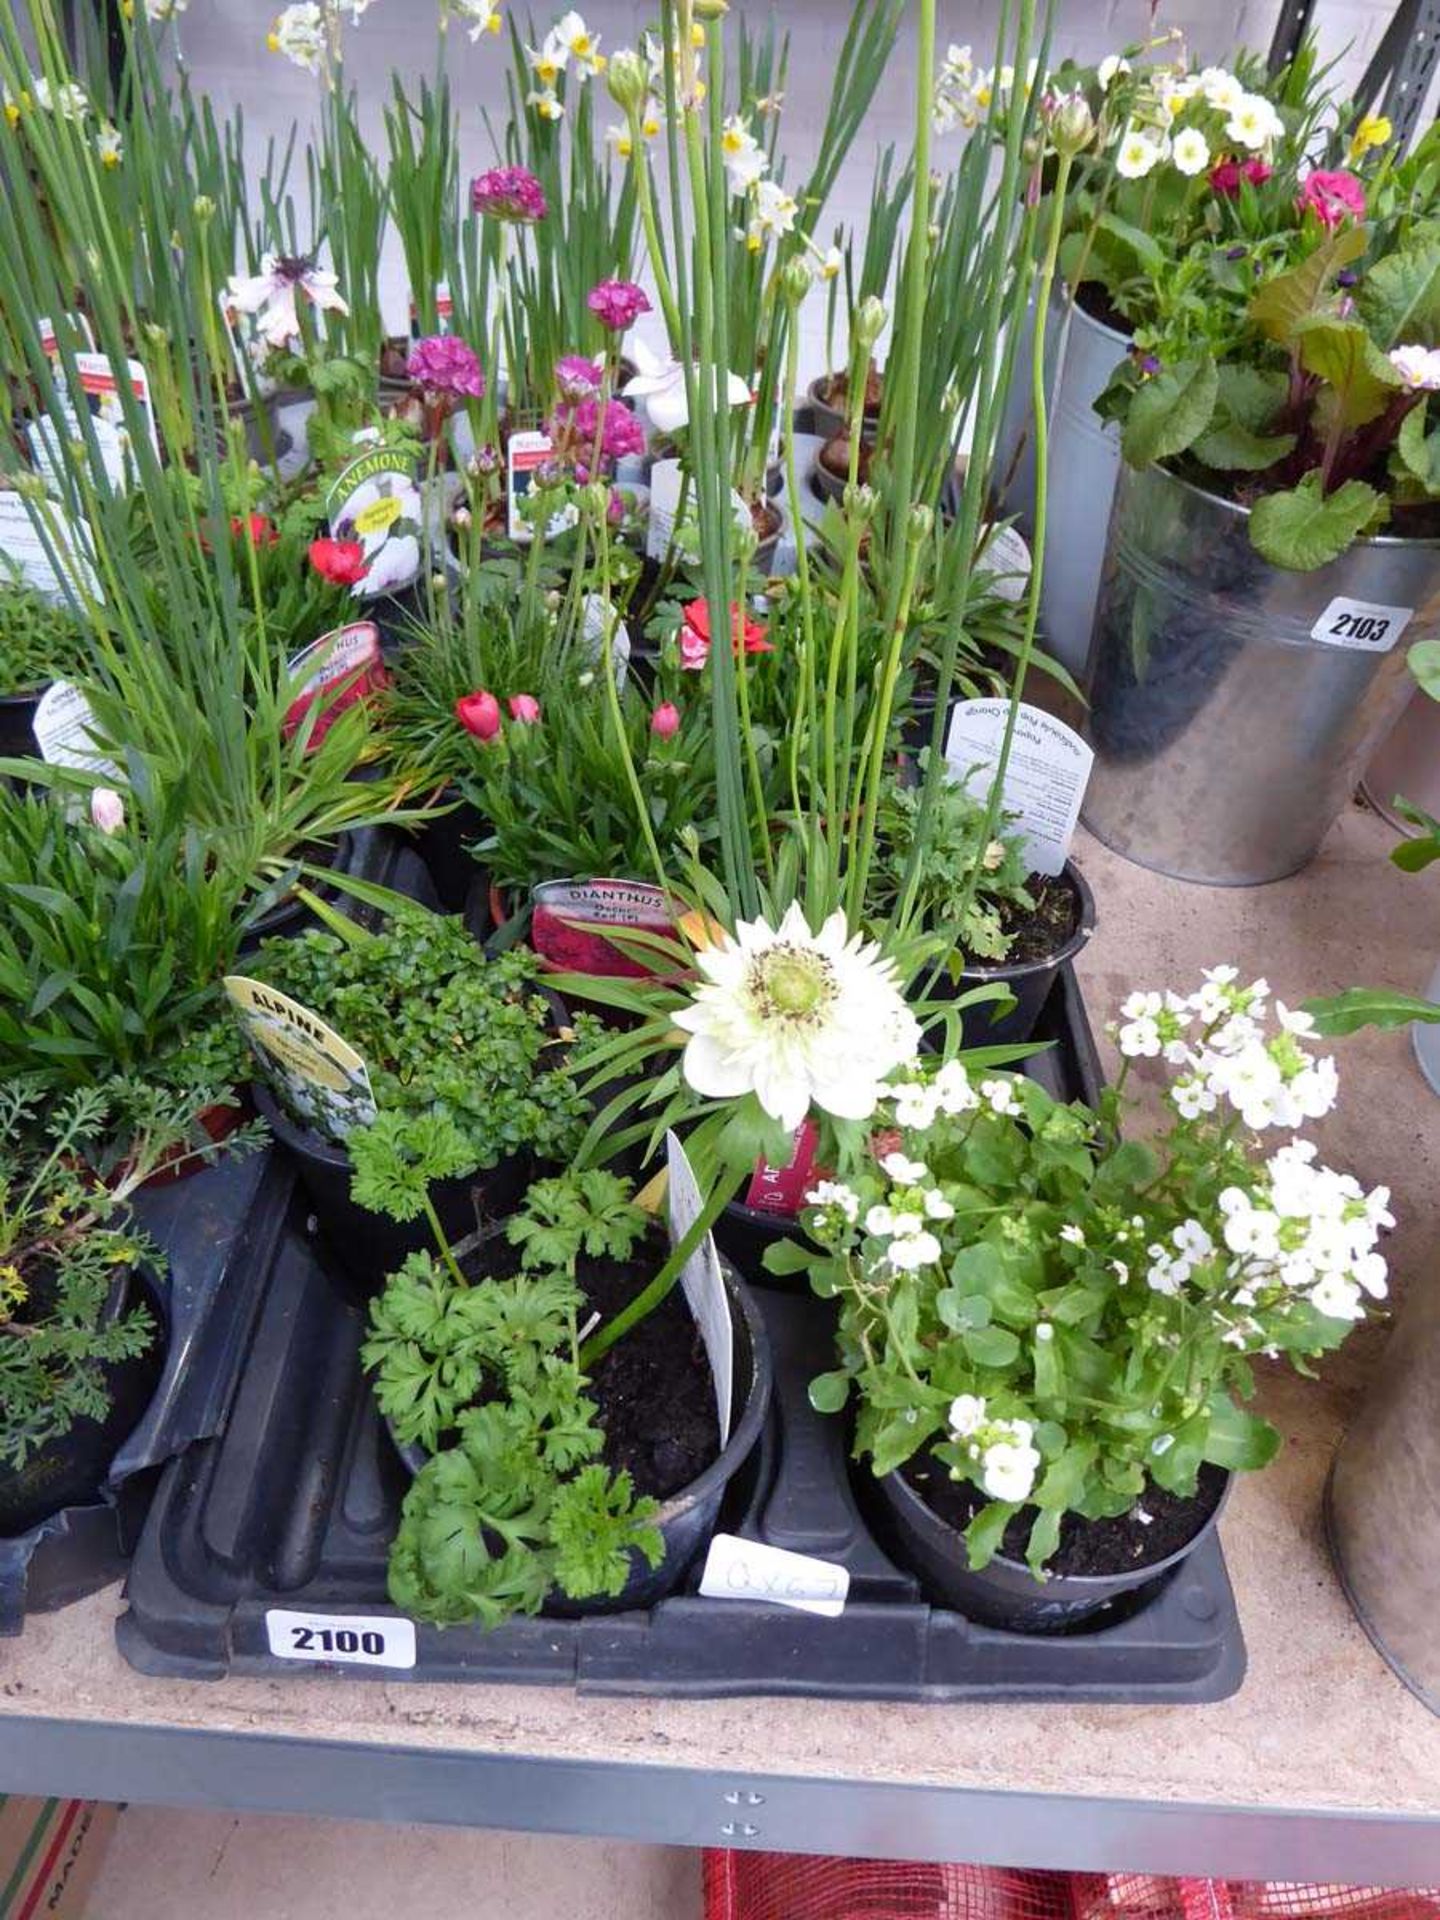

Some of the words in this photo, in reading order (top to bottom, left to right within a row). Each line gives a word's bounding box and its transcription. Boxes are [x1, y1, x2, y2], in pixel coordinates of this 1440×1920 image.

[1329, 613, 1390, 642] 2103
[569, 889, 663, 908] DIANTHUS
[251, 990, 325, 1044] ALPINE
[291, 1626, 385, 1656] 2100
[47, 1811, 93, 1911] MADE
